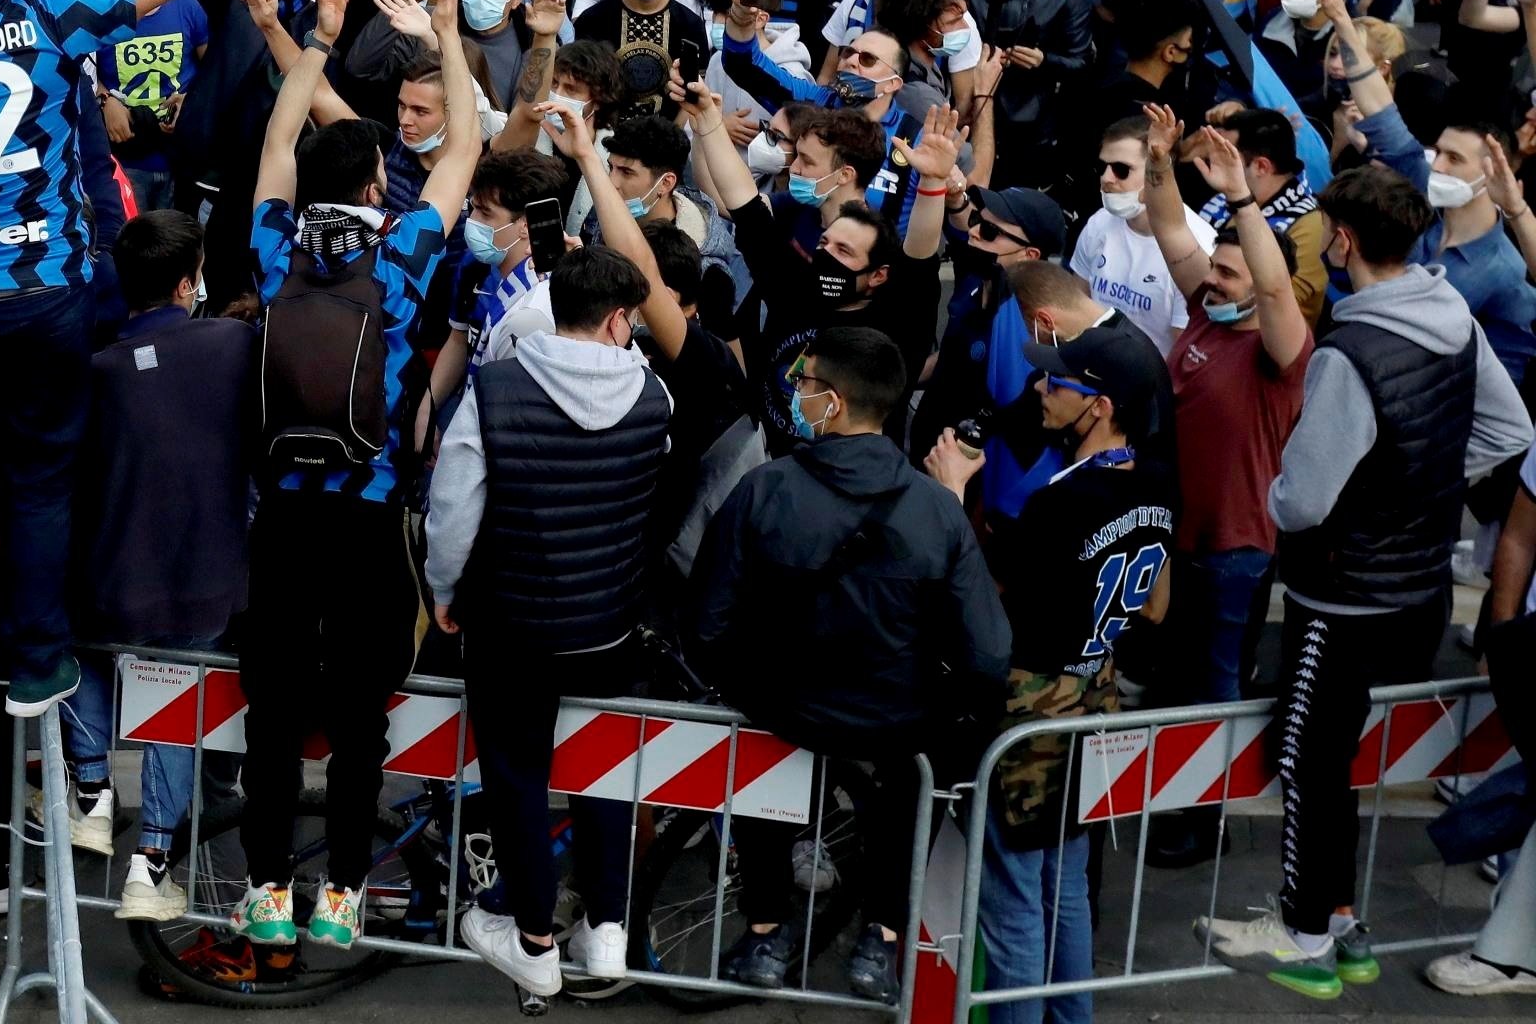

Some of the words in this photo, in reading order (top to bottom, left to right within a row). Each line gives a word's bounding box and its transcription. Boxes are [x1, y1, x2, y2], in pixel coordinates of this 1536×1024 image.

[123, 40, 175, 67] 635
[819, 275, 846, 284] BARCOLLO
[129, 663, 156, 673] Comune
[168, 667, 191, 676] Milano
[137, 674, 159, 683] Polizia
[161, 676, 182, 685] Locale
[1089, 738, 1113, 747] Comne
[1123, 734, 1144, 742] Milano
[779, 810, 804, 819] (Perugia)
